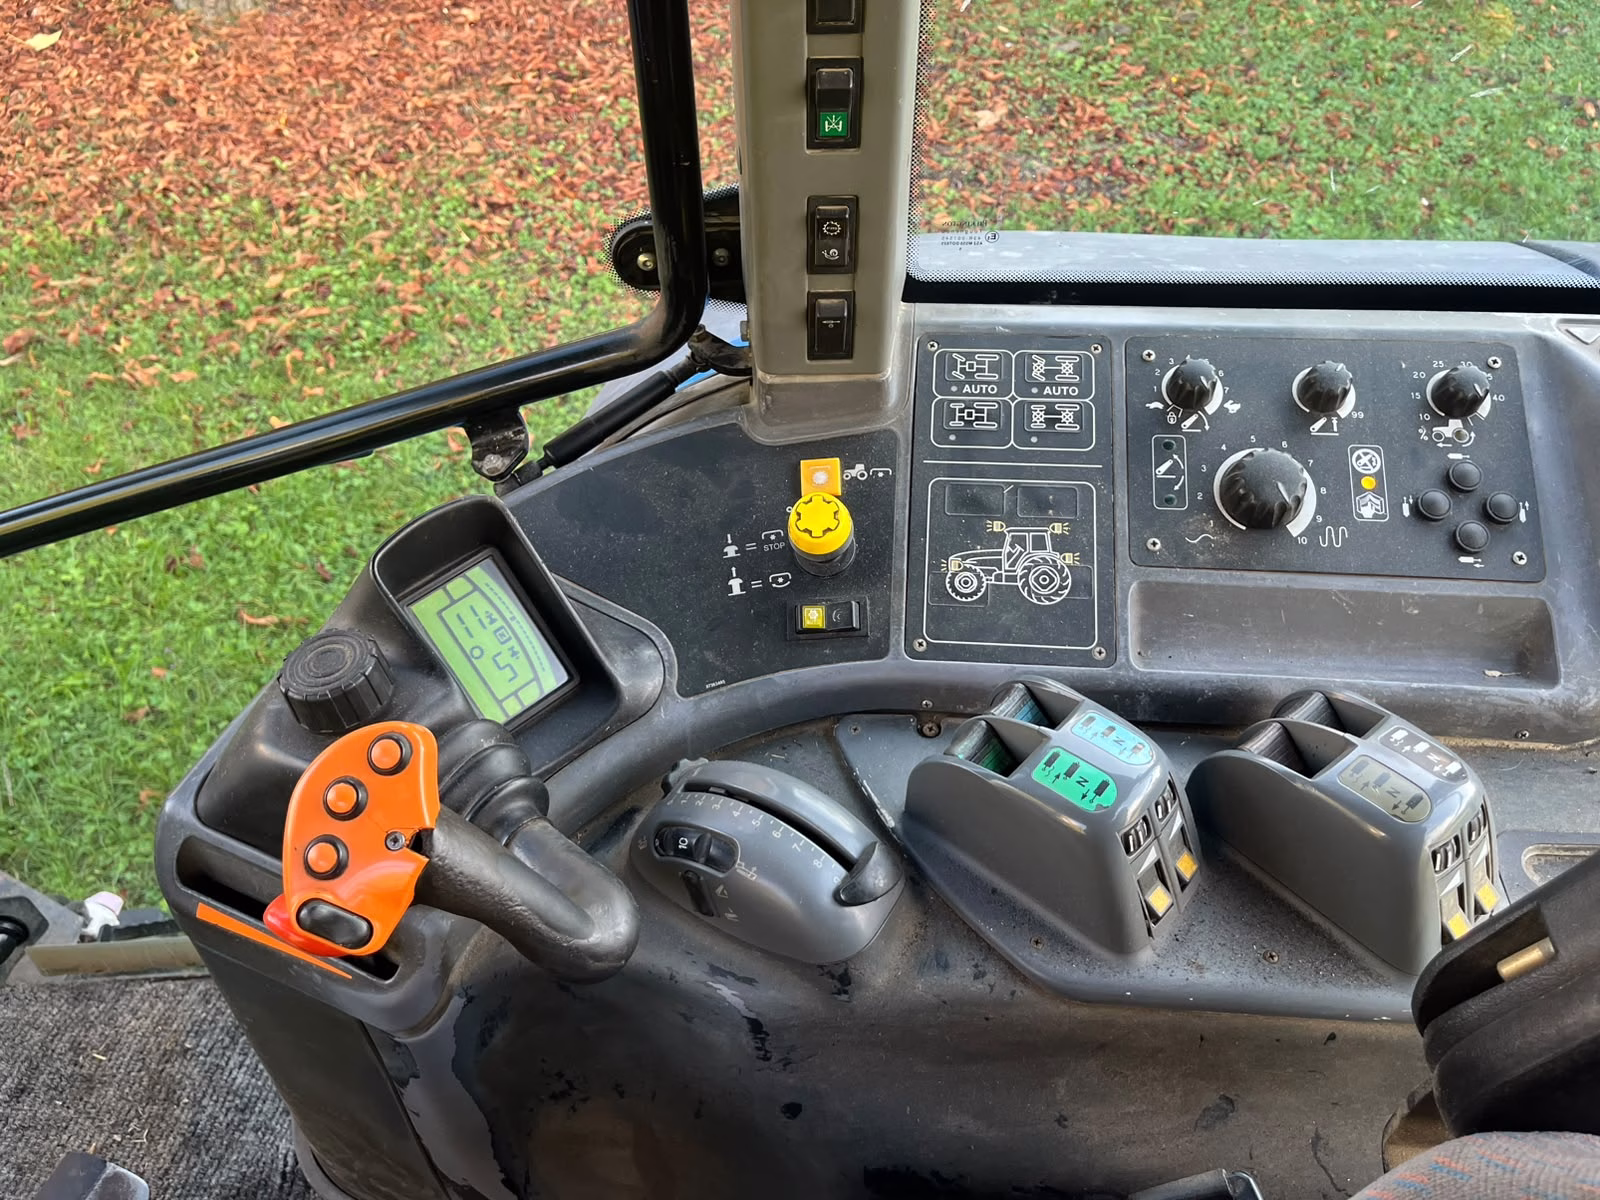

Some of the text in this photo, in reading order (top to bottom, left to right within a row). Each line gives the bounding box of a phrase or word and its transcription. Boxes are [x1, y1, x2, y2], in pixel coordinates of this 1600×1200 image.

[962, 384, 998, 394] AUTO
[1043, 386, 1079, 396] AUTO
[763, 541, 786, 552] STOP
[1075, 775, 1089, 788] N
[1386, 787, 1400, 798] N
[752, 819, 760, 827] 5
[678, 837, 689, 849] 10
[792, 843, 801, 852] 7
[813, 859, 823, 868] 8
